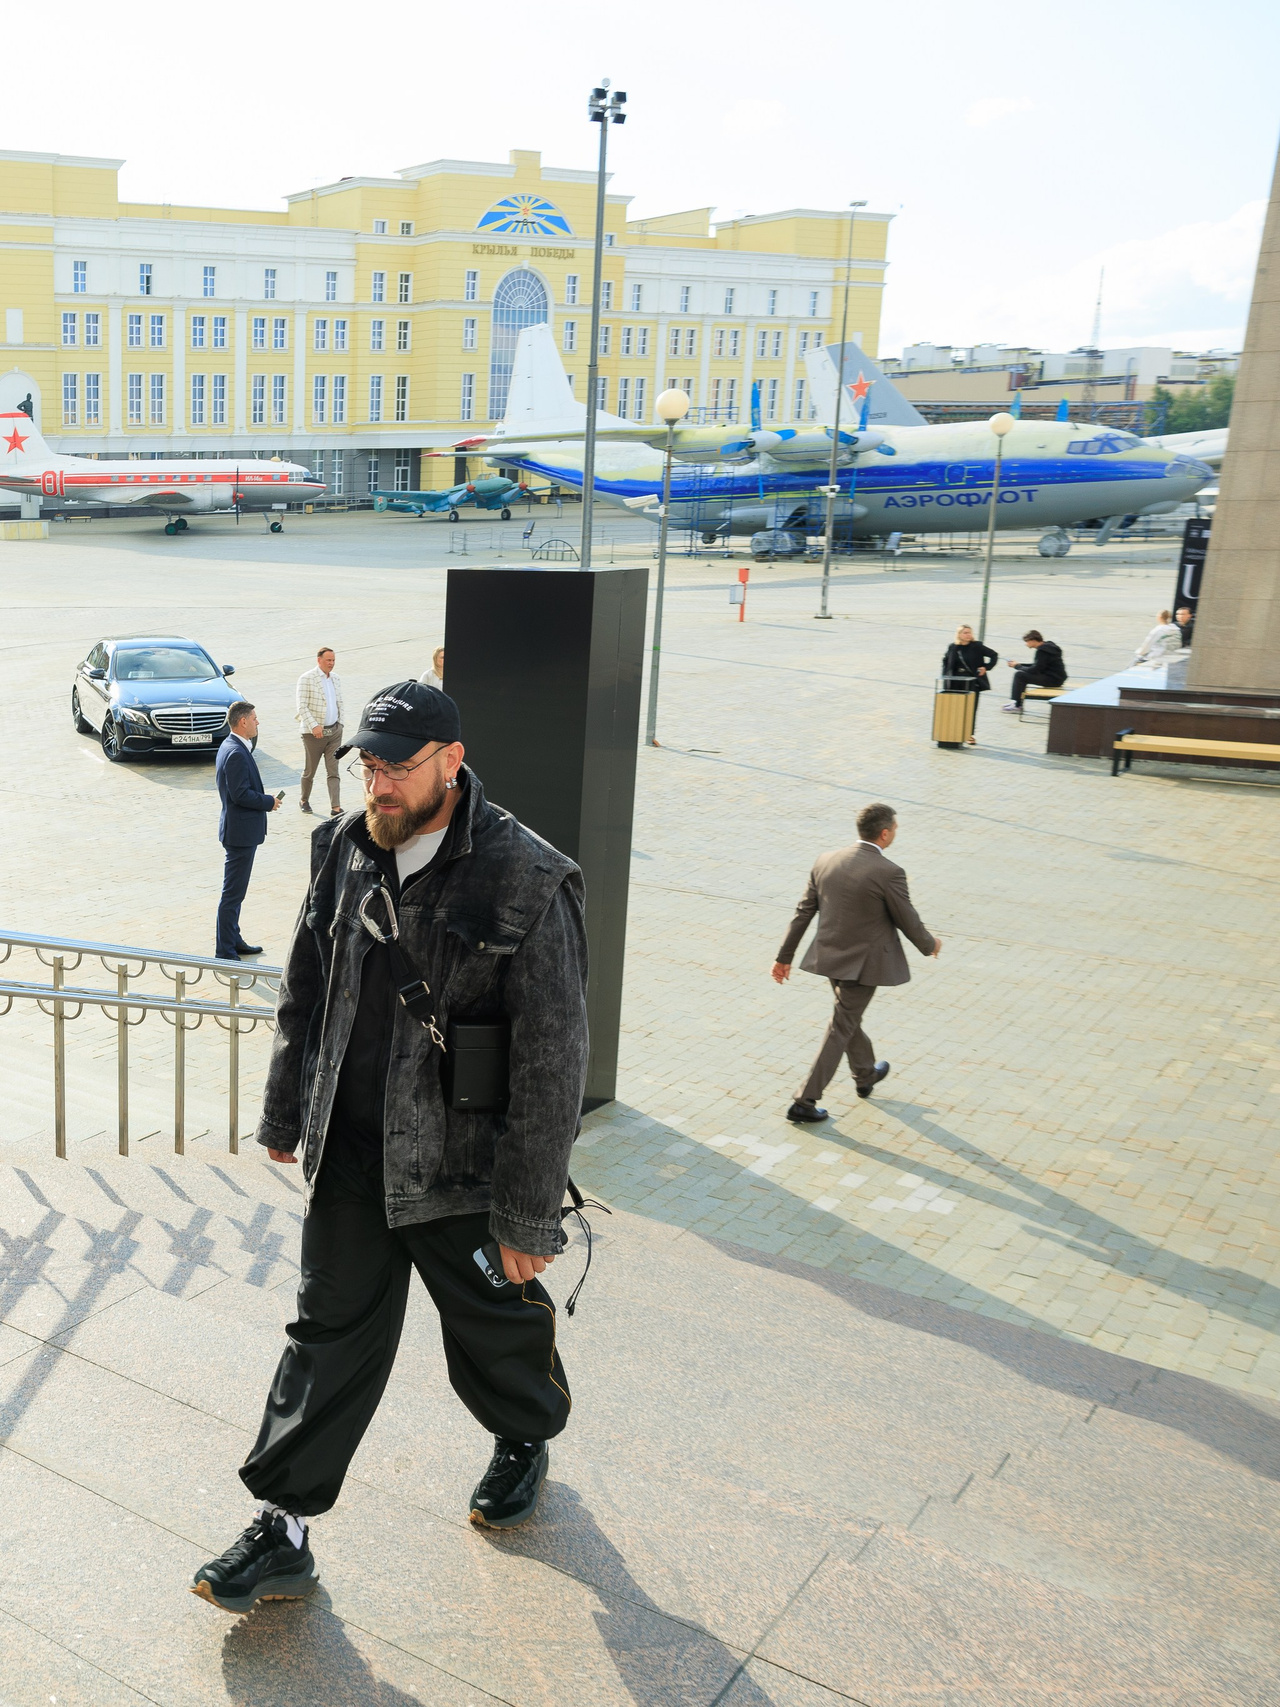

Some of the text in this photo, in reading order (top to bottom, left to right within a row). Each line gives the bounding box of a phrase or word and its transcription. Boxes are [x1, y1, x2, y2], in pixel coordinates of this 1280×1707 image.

[472, 243, 576, 260] КРЫЛЬЯ ПОБЕДЫ
[41, 469, 65, 497] 01
